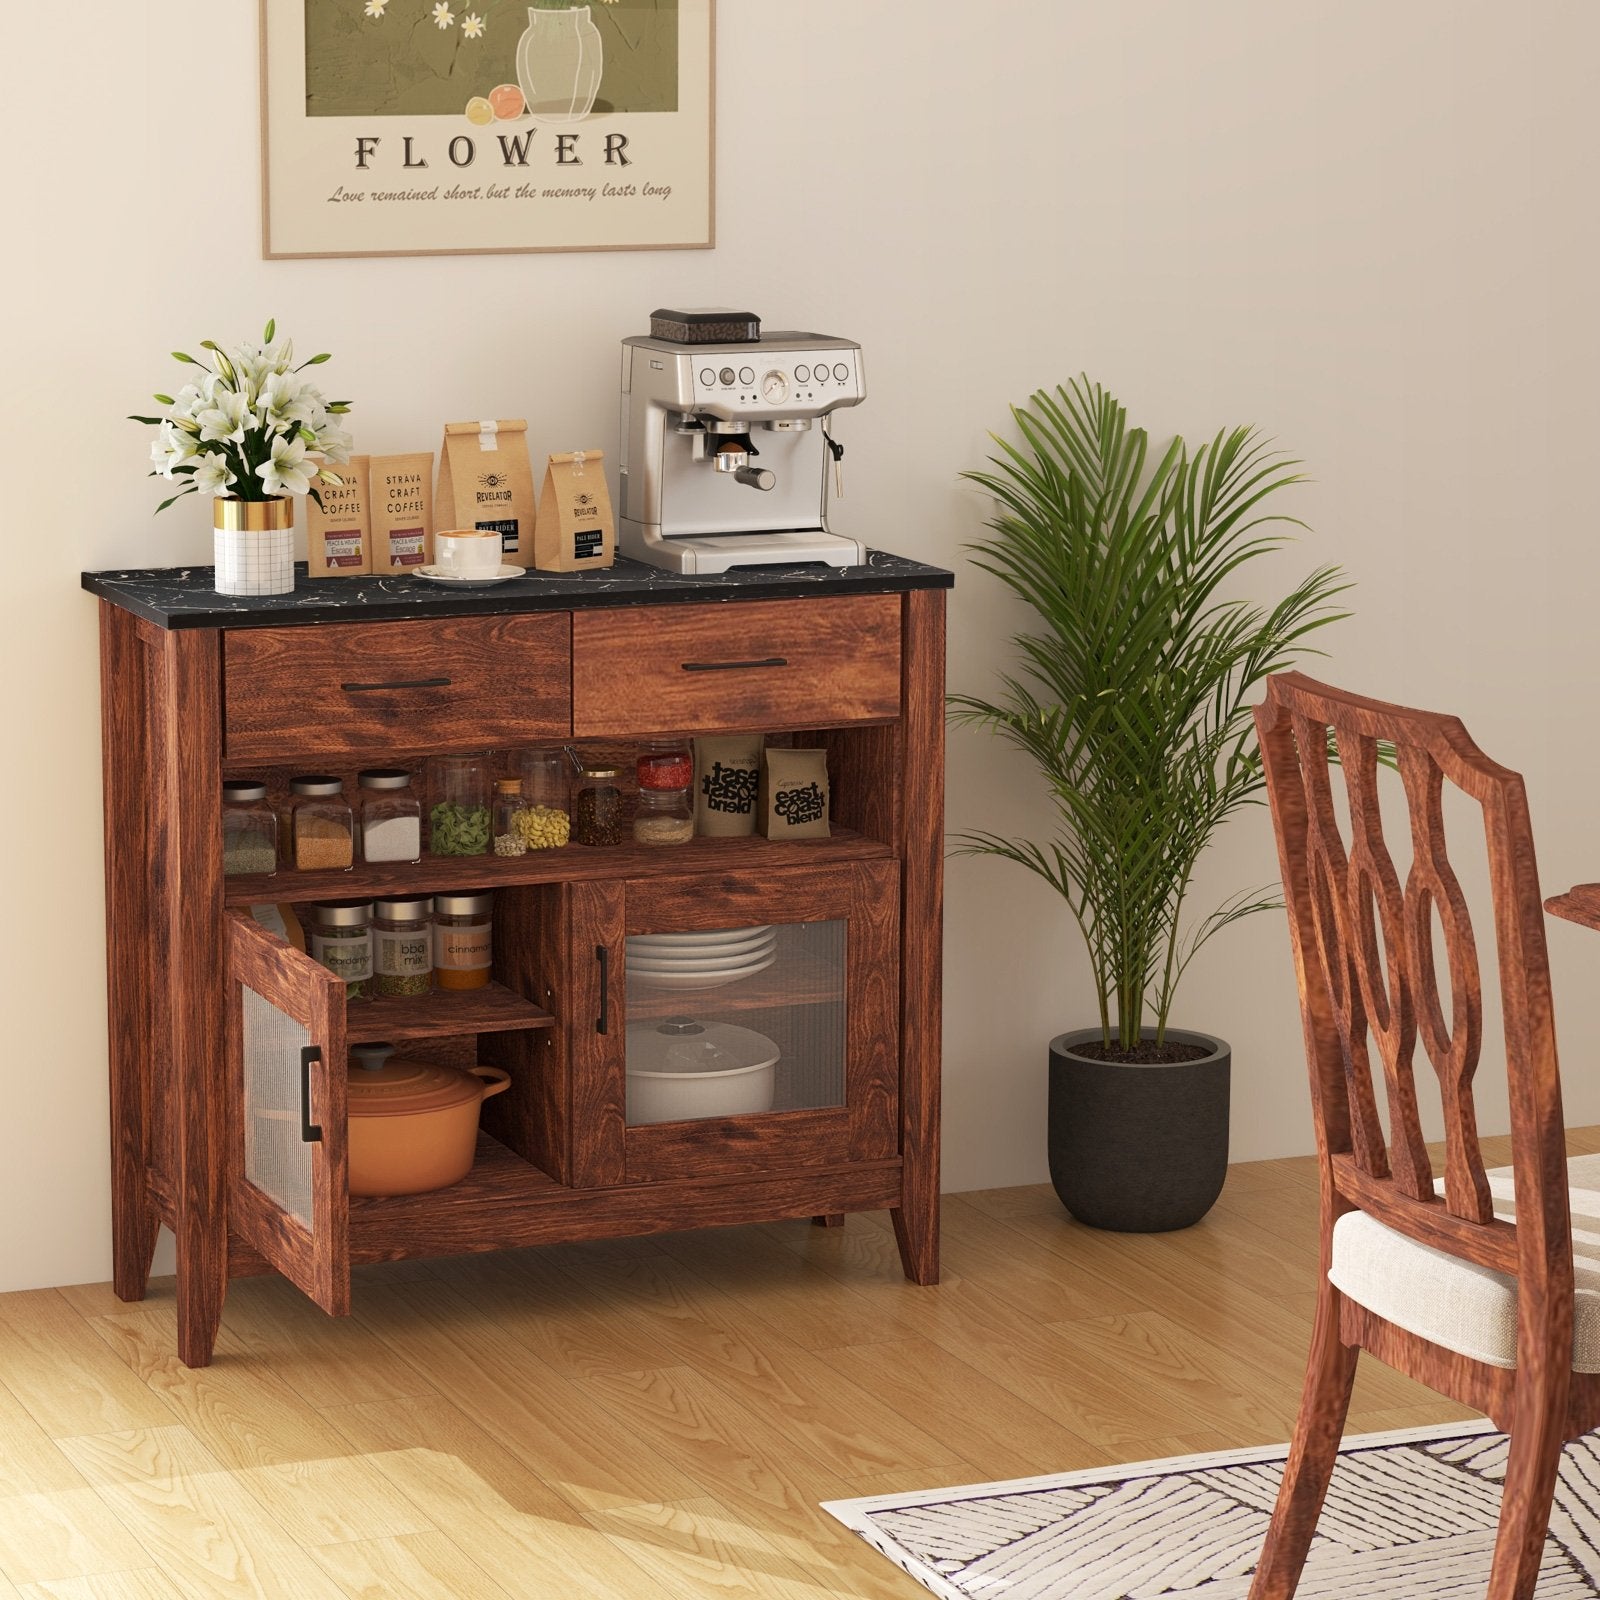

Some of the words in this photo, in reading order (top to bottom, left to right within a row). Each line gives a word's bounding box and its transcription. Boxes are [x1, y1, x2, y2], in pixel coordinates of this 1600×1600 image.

[354, 127, 632, 169] FLOWER
[327, 186, 365, 203] Love
[371, 186, 438, 201] remained
[514, 182, 537, 199] the
[542, 185, 596, 202] memory
[601, 182, 637, 197] lasts
[641, 181, 673, 201] long
[386, 474, 421, 485] STRAVA
[324, 489, 356, 500] CRAFT
[389, 487, 420, 498] CRAFT
[477, 490, 512, 503] REVELATOR
[322, 503, 361, 515] COFFEE
[387, 501, 424, 513] COFFEE
[574, 506, 598, 518] REVELATOR
[495, 524, 515, 532] RIDER
[776, 782, 818, 804] east
[774, 791, 826, 816] coast
[786, 805, 823, 826] blend
[401, 943, 425, 956] bbq
[404, 956, 424, 965] mix
